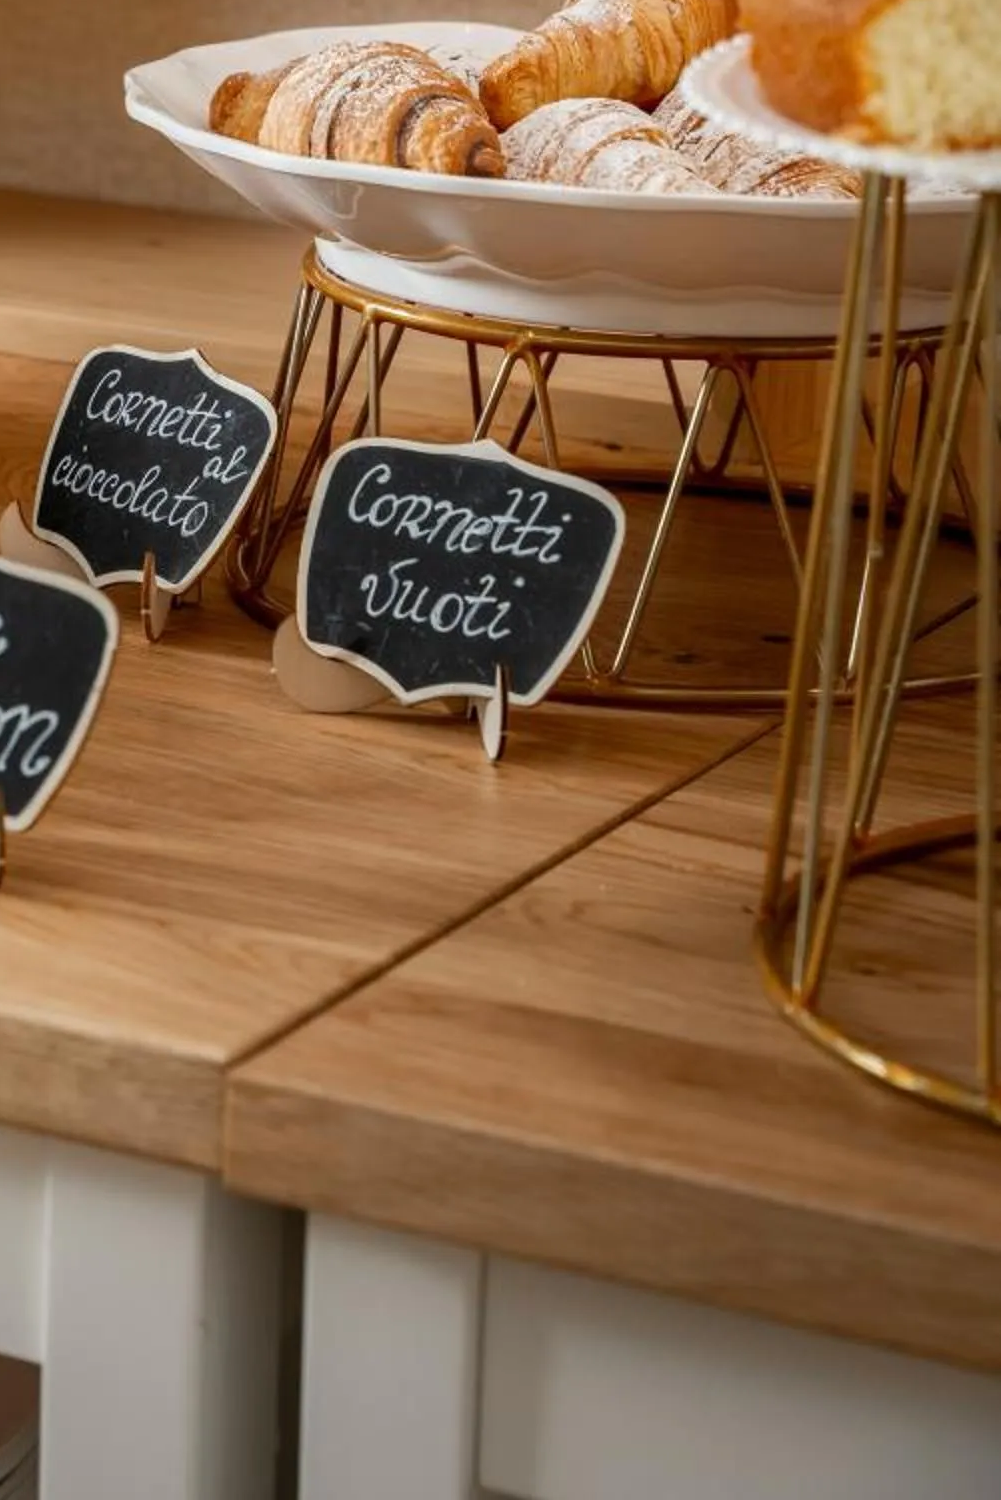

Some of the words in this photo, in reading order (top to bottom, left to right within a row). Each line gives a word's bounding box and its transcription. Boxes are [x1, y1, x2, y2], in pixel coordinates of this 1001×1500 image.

[86, 369, 232, 450] Cornetti
[51, 445, 208, 537] cioccolato
[202, 445, 248, 484] al
[349, 464, 572, 563] Cornetti
